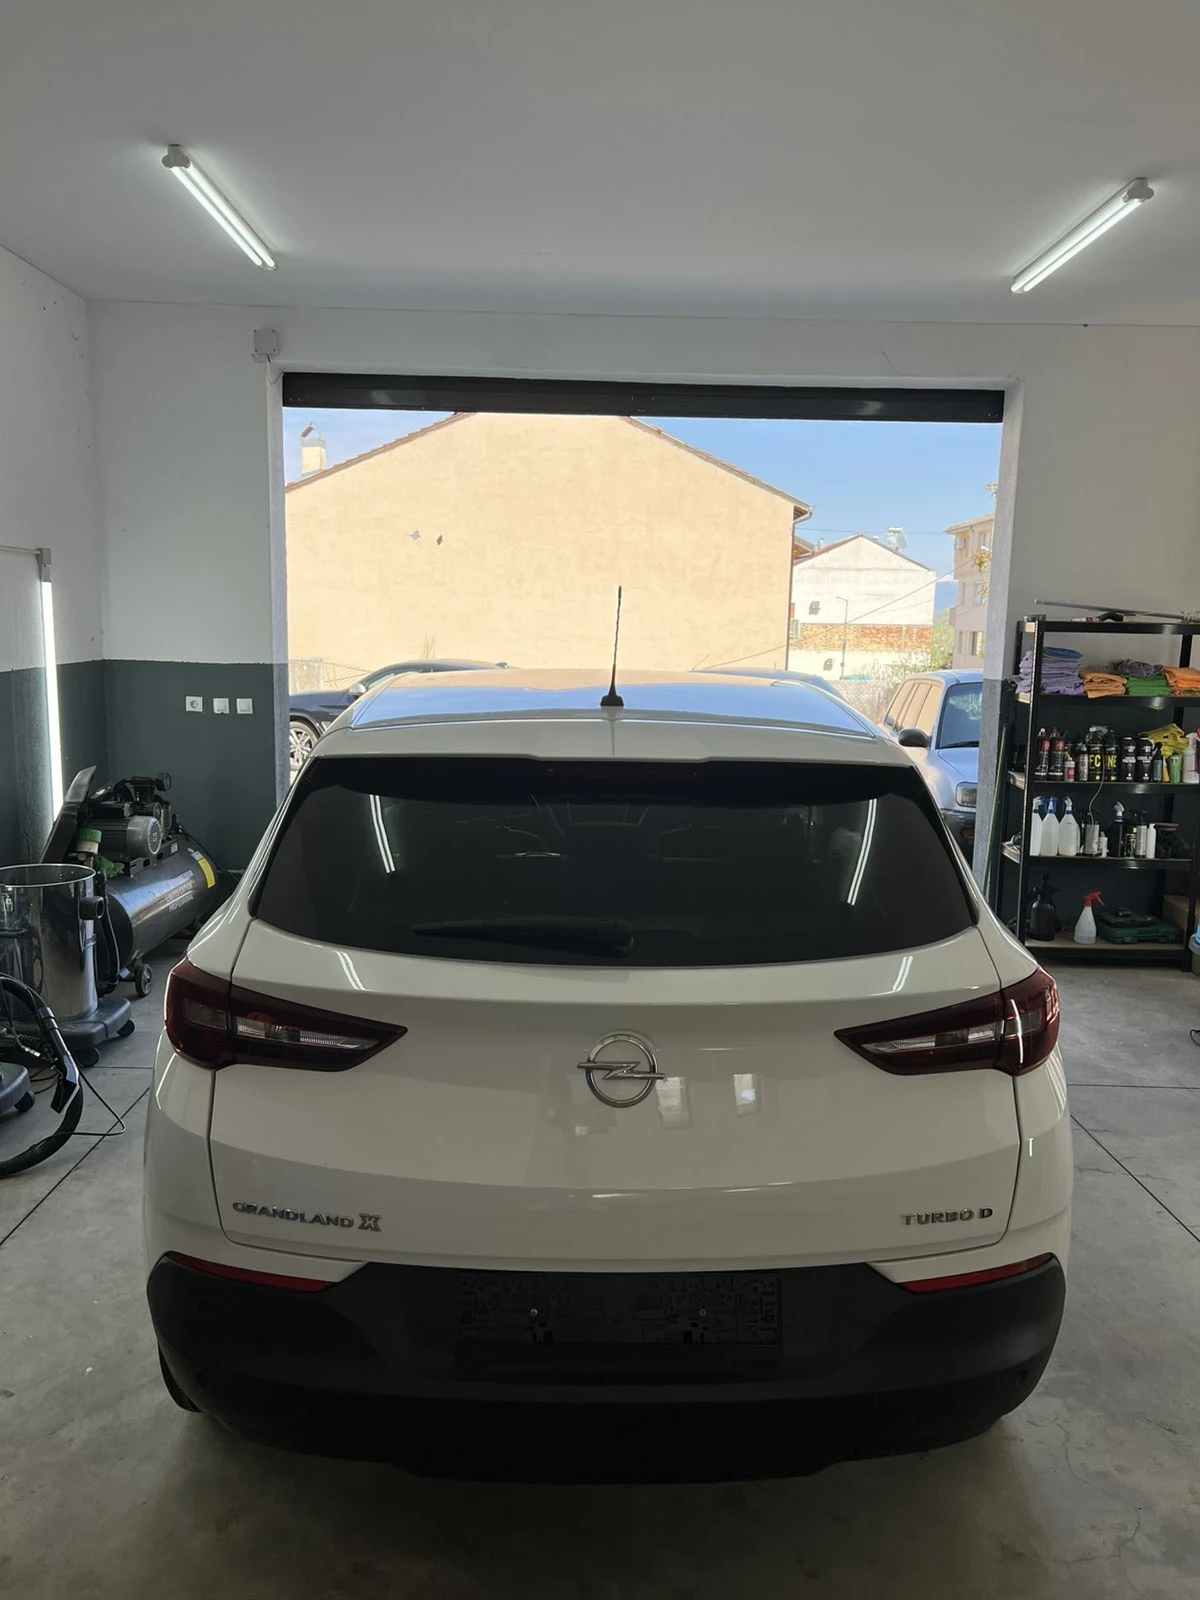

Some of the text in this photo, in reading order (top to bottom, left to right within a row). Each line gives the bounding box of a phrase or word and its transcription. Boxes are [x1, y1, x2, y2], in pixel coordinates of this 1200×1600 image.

[232, 1202, 382, 1232] GRANDLAND X
[901, 1207, 993, 1226] TURBO D
